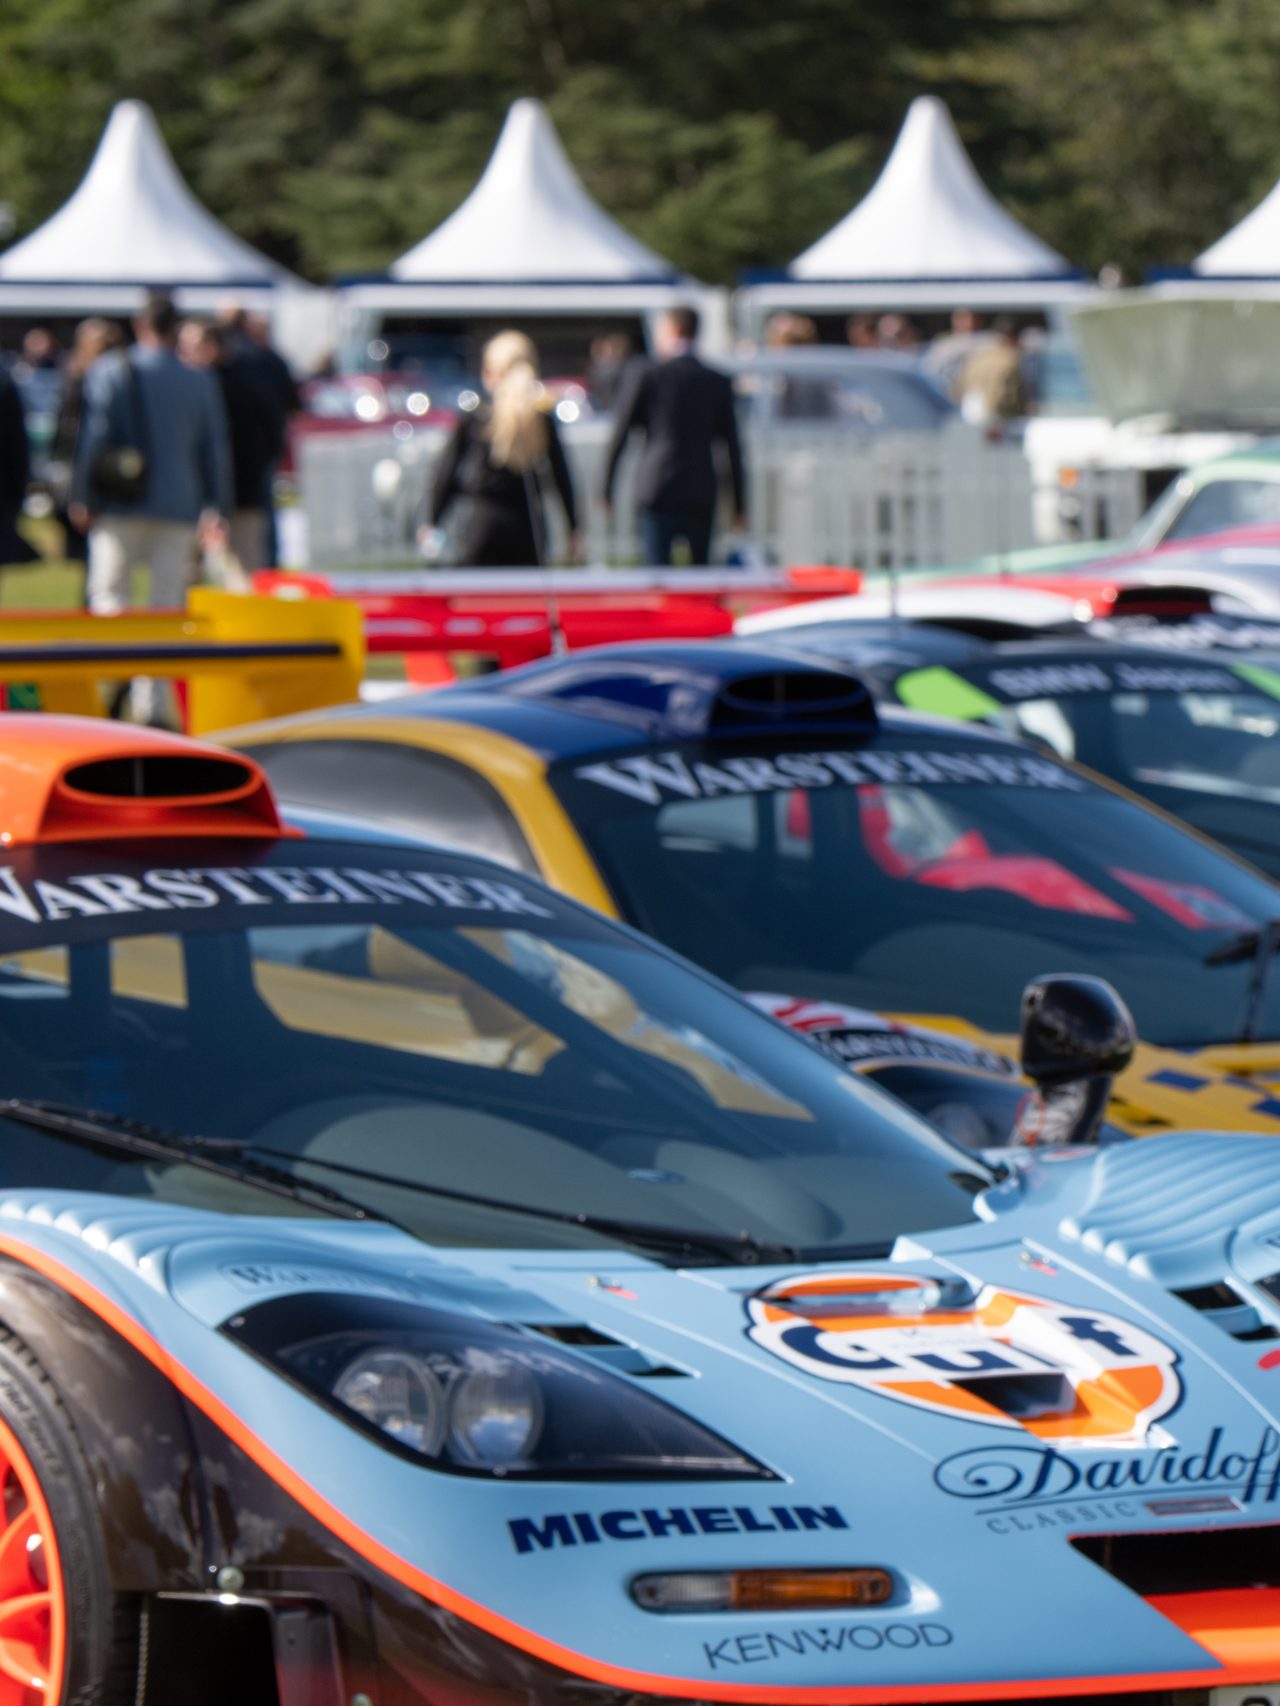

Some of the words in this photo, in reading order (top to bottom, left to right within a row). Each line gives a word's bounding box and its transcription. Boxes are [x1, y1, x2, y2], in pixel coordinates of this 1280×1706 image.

[574, 750, 1087, 805] WARSTEINER
[506, 1505, 850, 1554] MICHELIN
[986, 1501, 1138, 1535] CLASSIC
[703, 1623, 954, 1670] KENWOOD
